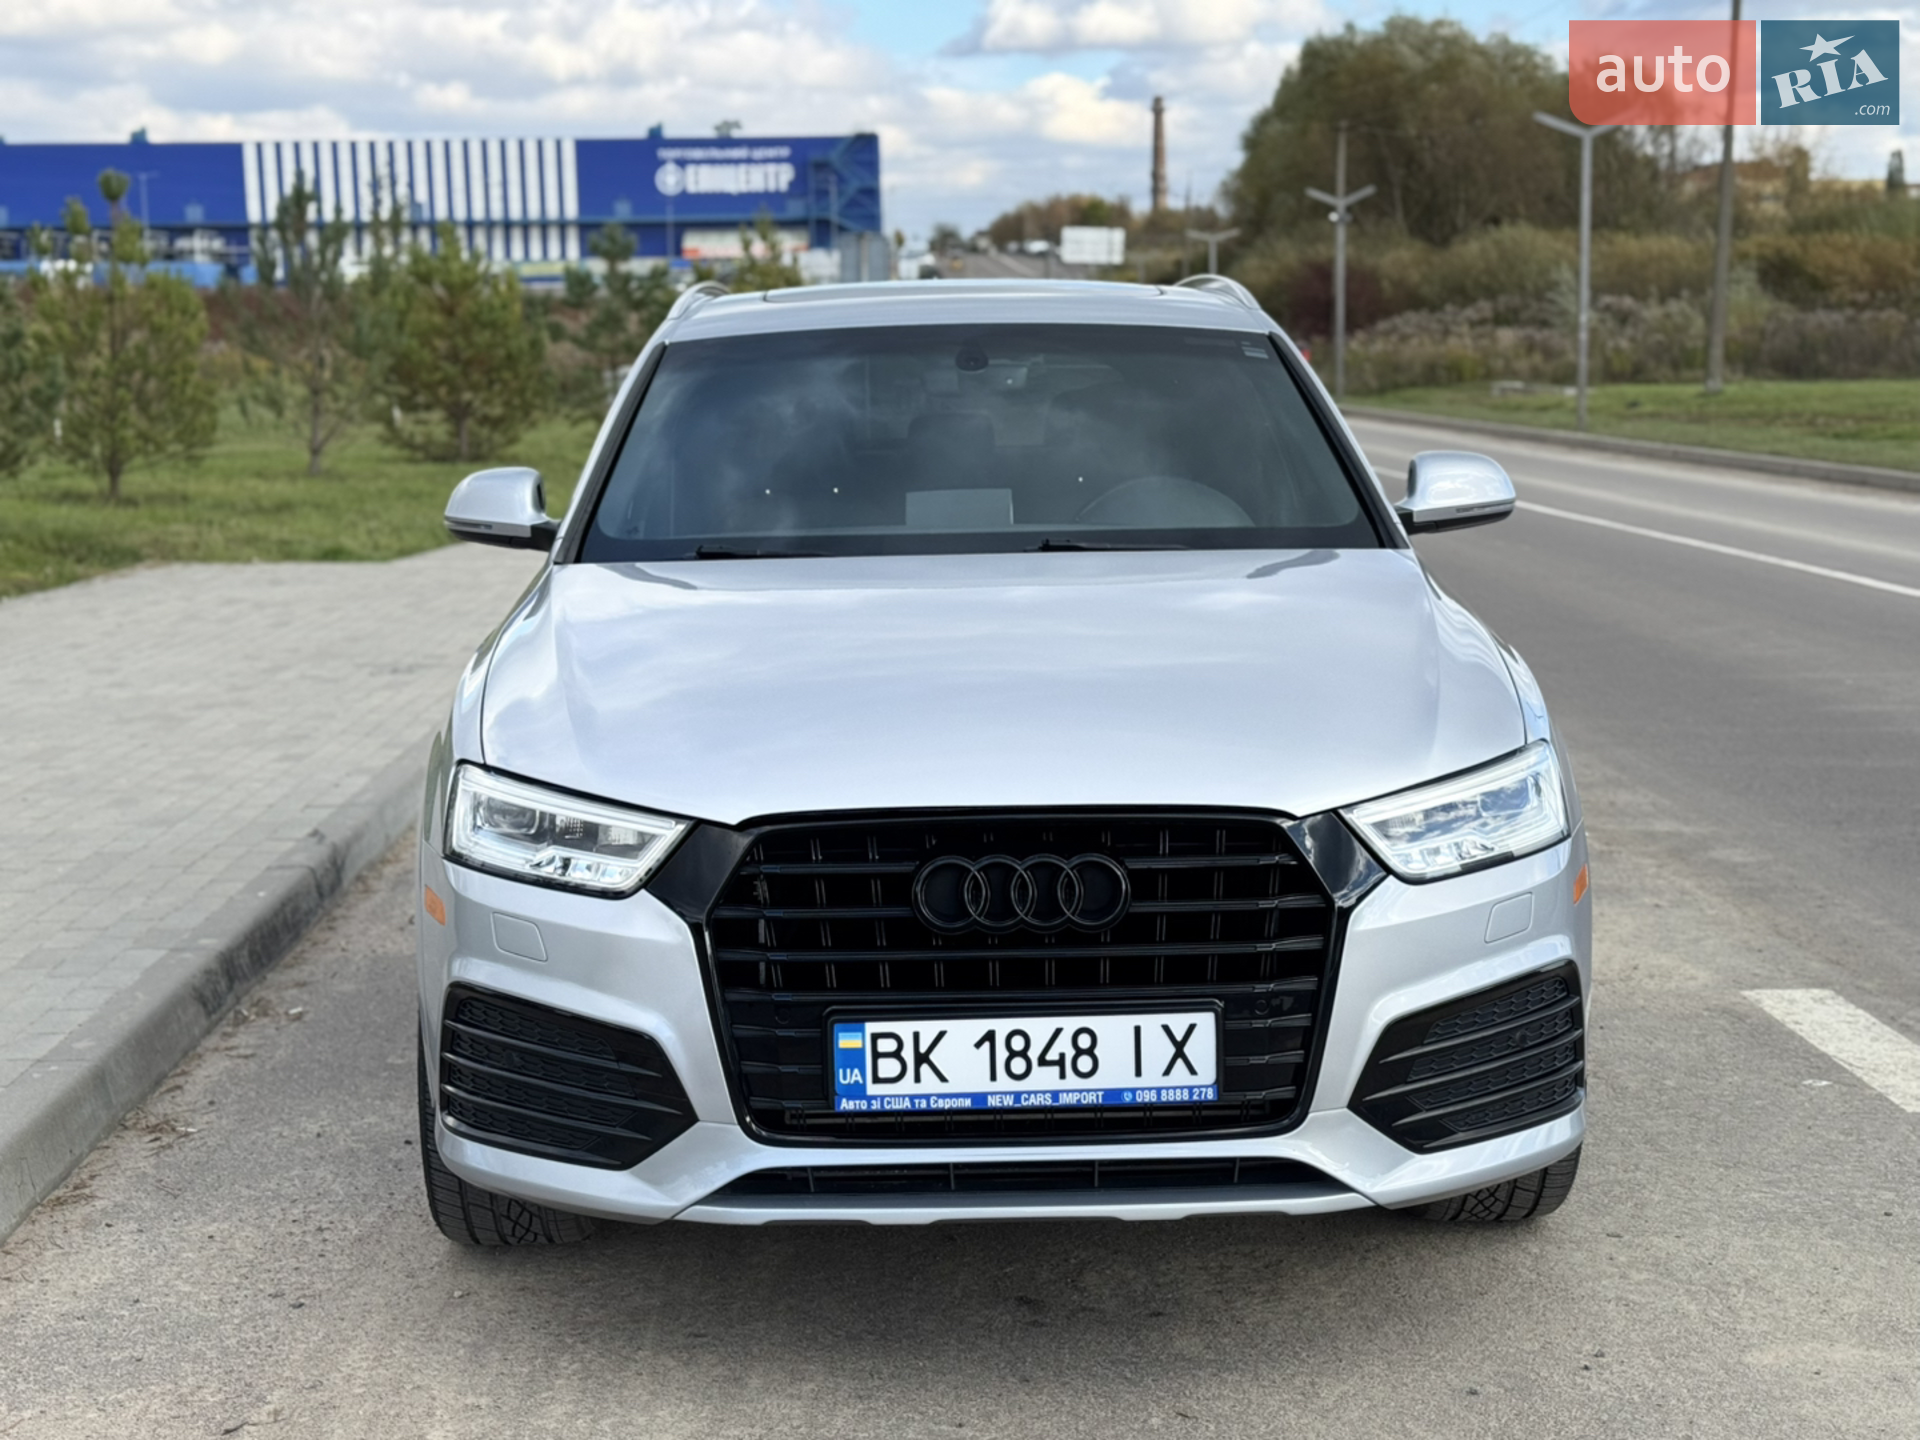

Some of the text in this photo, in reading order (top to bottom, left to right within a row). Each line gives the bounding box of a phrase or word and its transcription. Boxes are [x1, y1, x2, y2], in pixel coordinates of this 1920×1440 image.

[870, 1023, 1198, 1084] BK 1848 IX
[839, 1068, 863, 1084] UA
[987, 1091, 1104, 1107] NEW_CARS_IMPORT
[1136, 1087, 1214, 1102] 096 8888 278
[840, 1096, 972, 1110] Авто зі США та Європи
